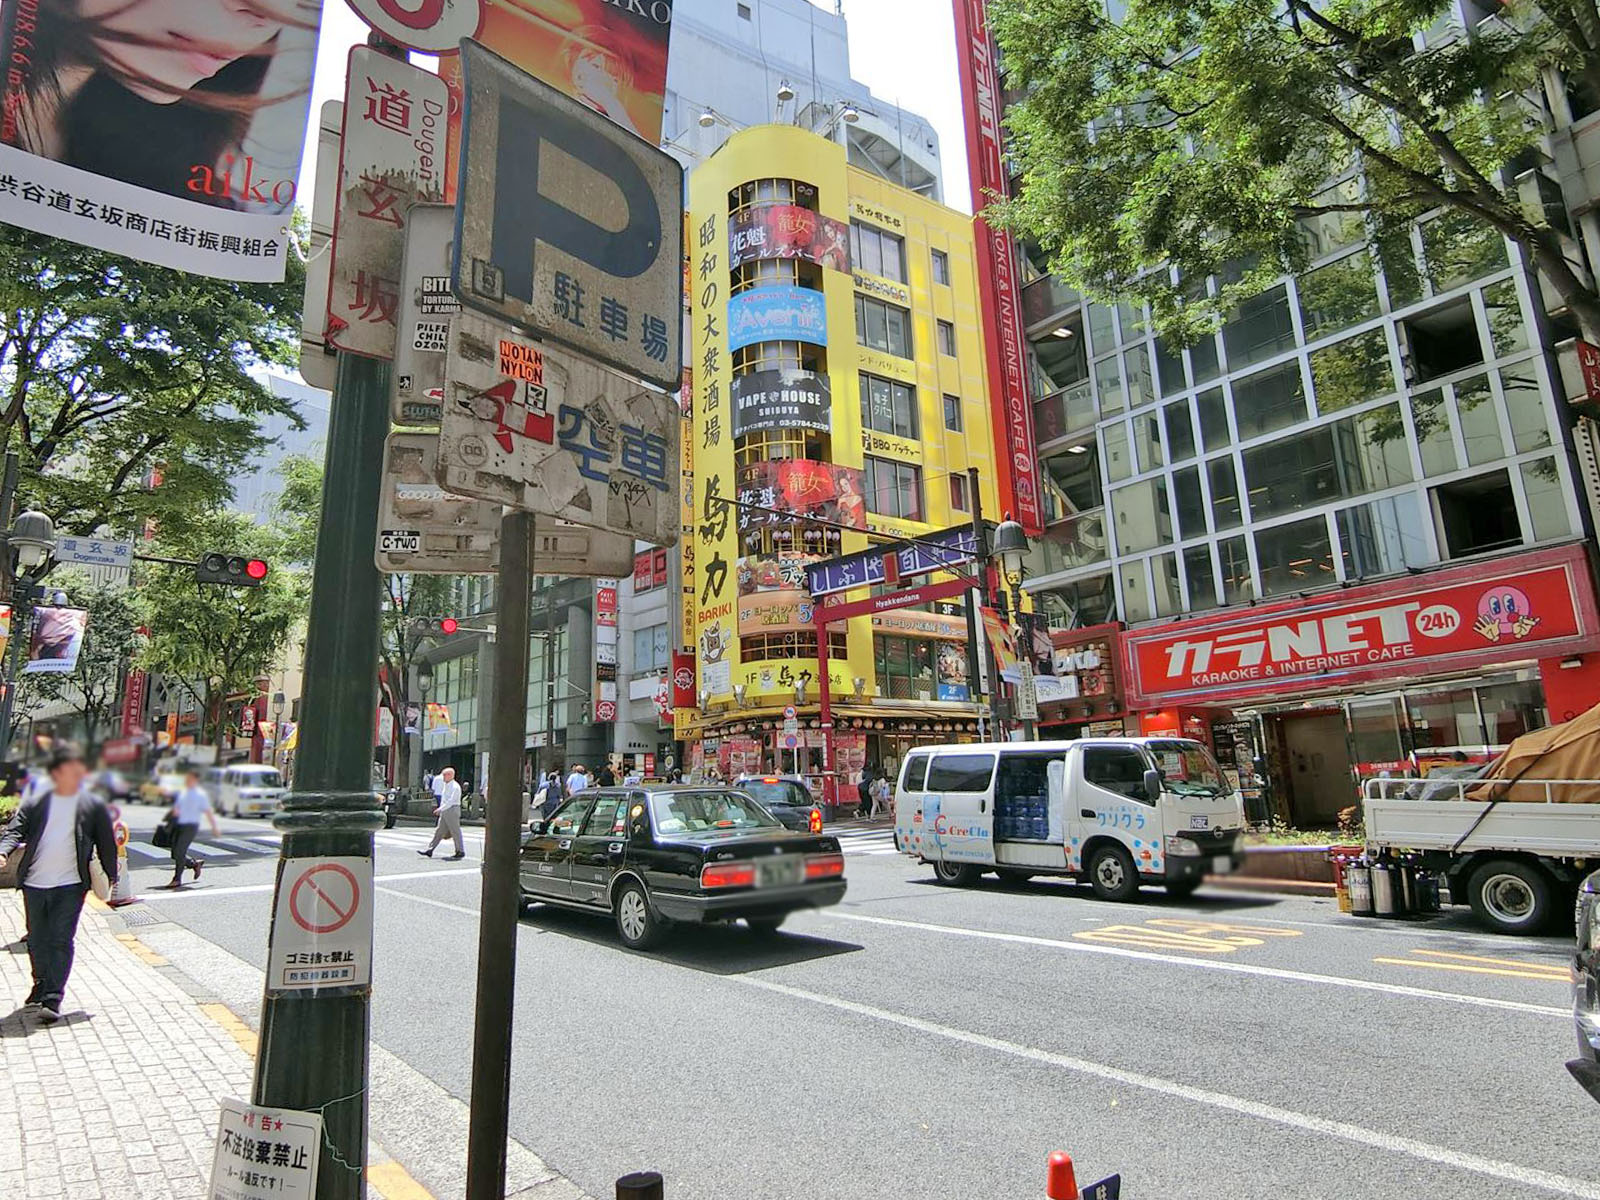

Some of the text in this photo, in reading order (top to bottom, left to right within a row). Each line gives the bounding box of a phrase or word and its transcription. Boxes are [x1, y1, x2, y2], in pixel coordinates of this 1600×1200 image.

[11, 0, 39, 66] 018.6.6
[187, 154, 297, 205] aiko
[348, 77, 413, 324] 道玄坂
[490, 98, 661, 307] P
[0, 174, 279, 258] 渋谷道玄坂商店街振興組合
[732, 226, 766, 253] 花魁
[554, 271, 669, 363] 駐車場
[699, 213, 722, 449] 昭和の大衆酒場
[501, 359, 543, 384] NYLON
[1001, 295, 1020, 390] INTERNET
[1011, 398, 1025, 450] CAFE
[738, 390, 821, 409] VAPE HOUSE
[557, 404, 670, 492] 空車
[873, 437, 890, 450] BBQ
[740, 487, 775, 512] 花魁
[62, 538, 128, 556] 道玄坂
[701, 474, 730, 606] 馬力
[73, 552, 115, 564] Dogenzaka
[698, 604, 732, 623] BARIKI
[943, 604, 954, 615] 3F
[1420, 611, 1456, 632] 24h
[1165, 602, 1420, 678] カラNET
[745, 671, 757, 684] 1F
[777, 665, 812, 687] 馬力
[1191, 643, 1415, 687] KARAOKE & INTERNET CAFE
[949, 826, 988, 837] CreCla
[1096, 812, 1145, 829] クリクラ
[286, 950, 354, 964] ゴミ捨て禁止
[222, 1129, 307, 1170] 不法投棄禁止
